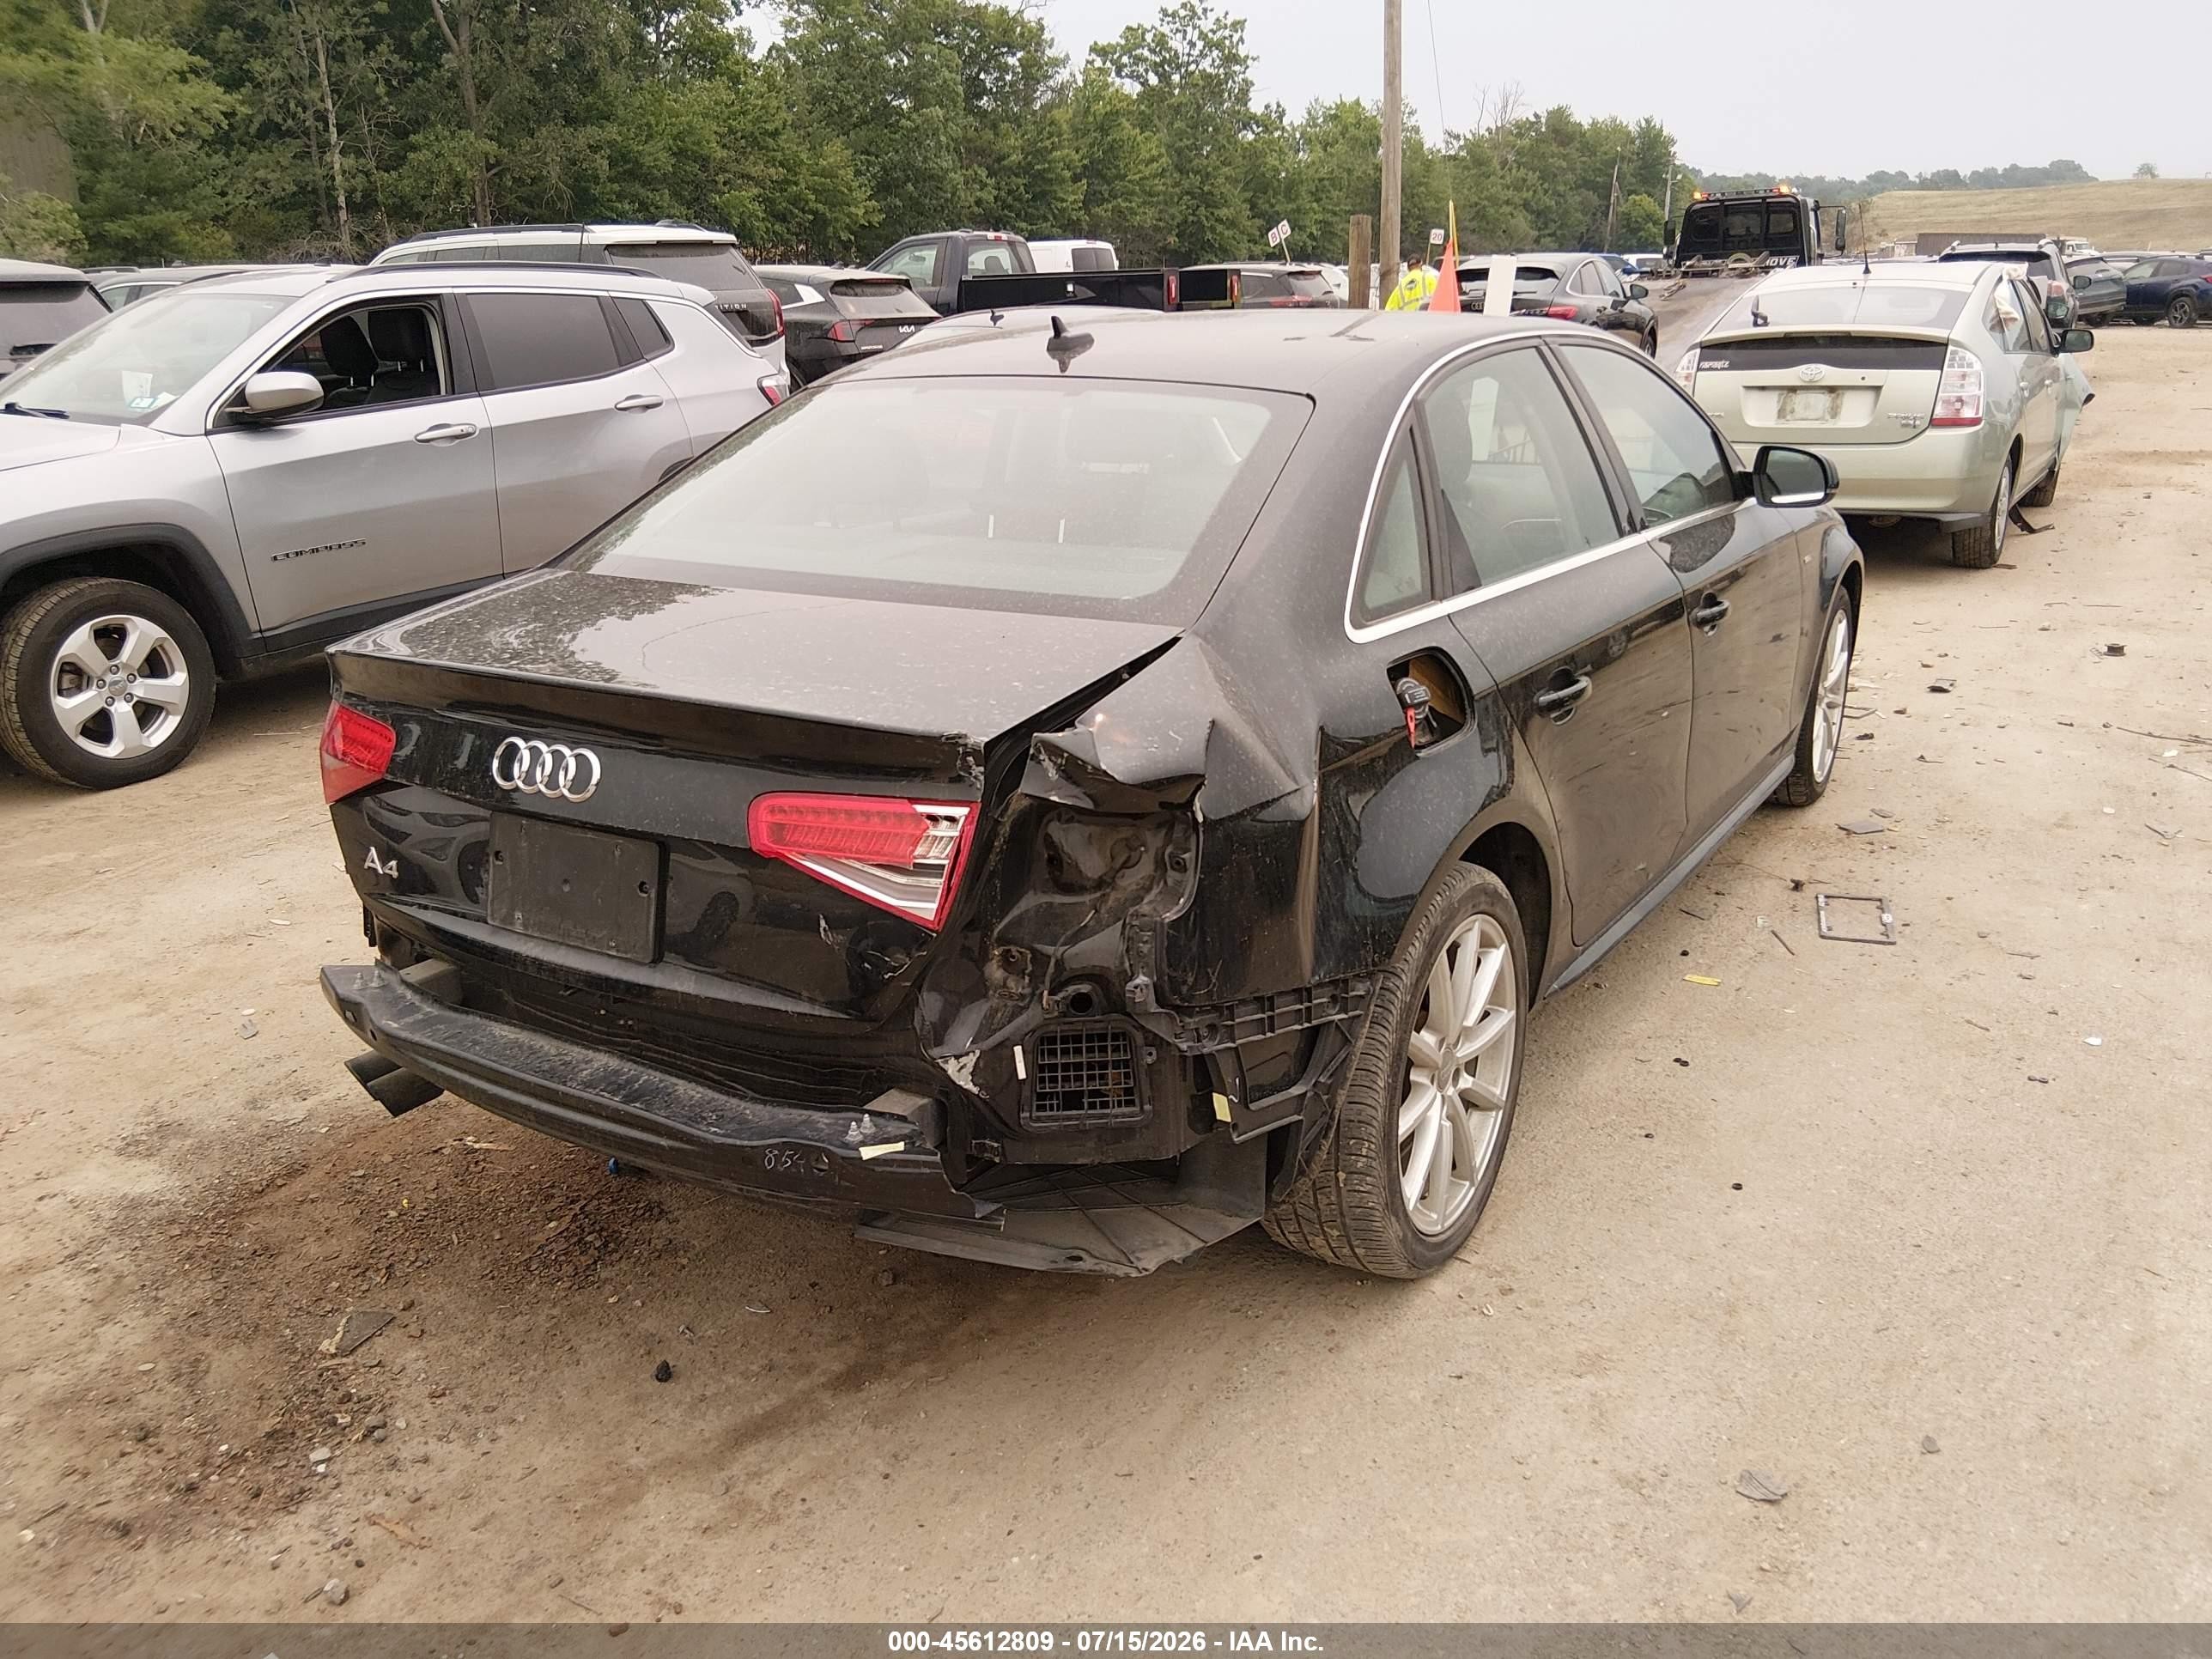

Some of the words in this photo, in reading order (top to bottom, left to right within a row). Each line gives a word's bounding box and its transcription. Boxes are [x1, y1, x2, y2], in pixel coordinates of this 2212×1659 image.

[1280, 224, 1289, 234] C
[1271, 232, 1278, 243] B
[1432, 233, 1443, 241] 20
[270, 538, 366, 562] COMPASS
[364, 847, 398, 878] A4
